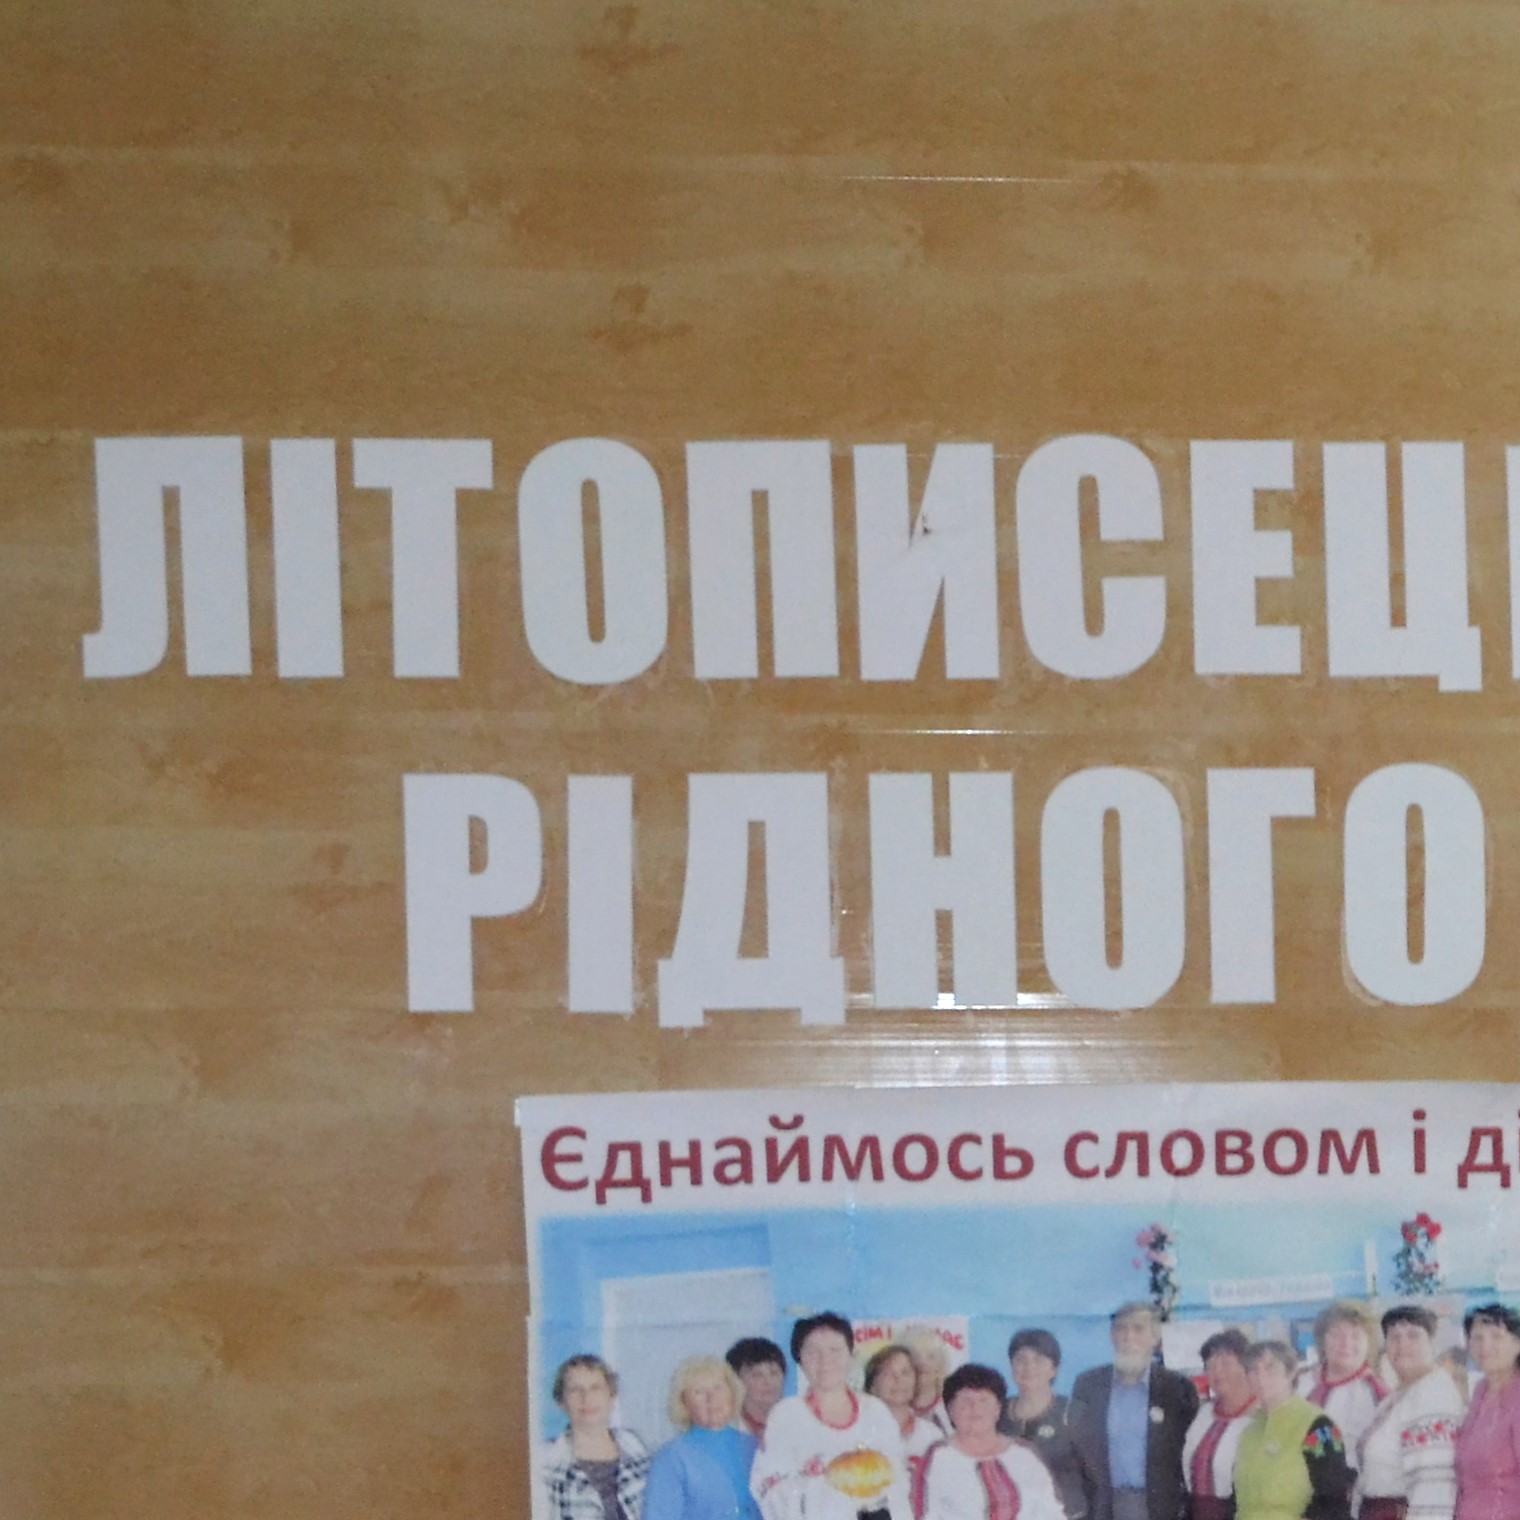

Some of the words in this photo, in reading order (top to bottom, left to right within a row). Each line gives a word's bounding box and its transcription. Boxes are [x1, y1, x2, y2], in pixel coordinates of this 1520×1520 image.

[402, 763, 1485, 1028] РІДНОГО
[540, 1113, 1036, 1205] Єднаймось
[1063, 1126, 1381, 1179] словом
[1411, 1107, 1427, 1174] і
